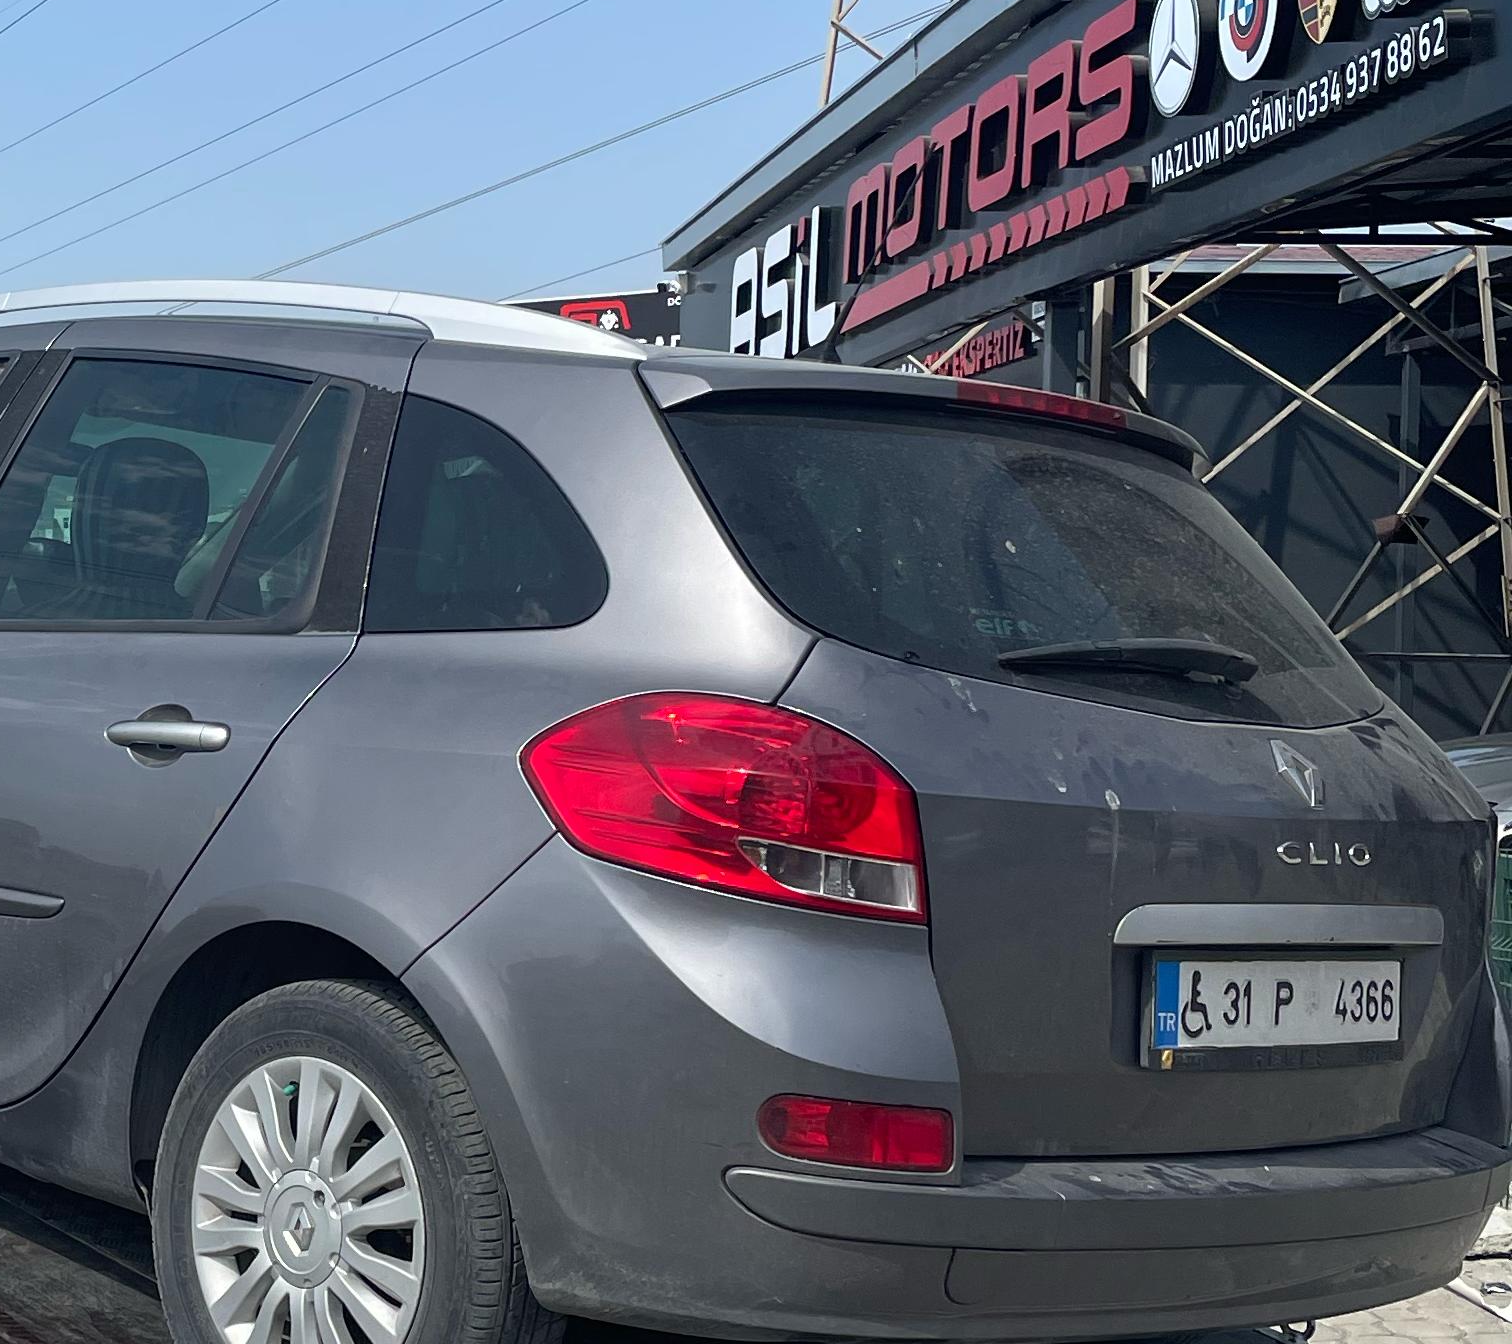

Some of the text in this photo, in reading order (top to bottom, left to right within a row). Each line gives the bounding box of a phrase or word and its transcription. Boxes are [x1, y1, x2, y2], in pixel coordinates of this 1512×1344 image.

[1150, 16, 1446, 188] MAZLUM DOĞAN: 0534 937 88 62
[1276, 841, 1372, 867] CLIO
[1157, 979, 1395, 1032] TR 31 P 4366
